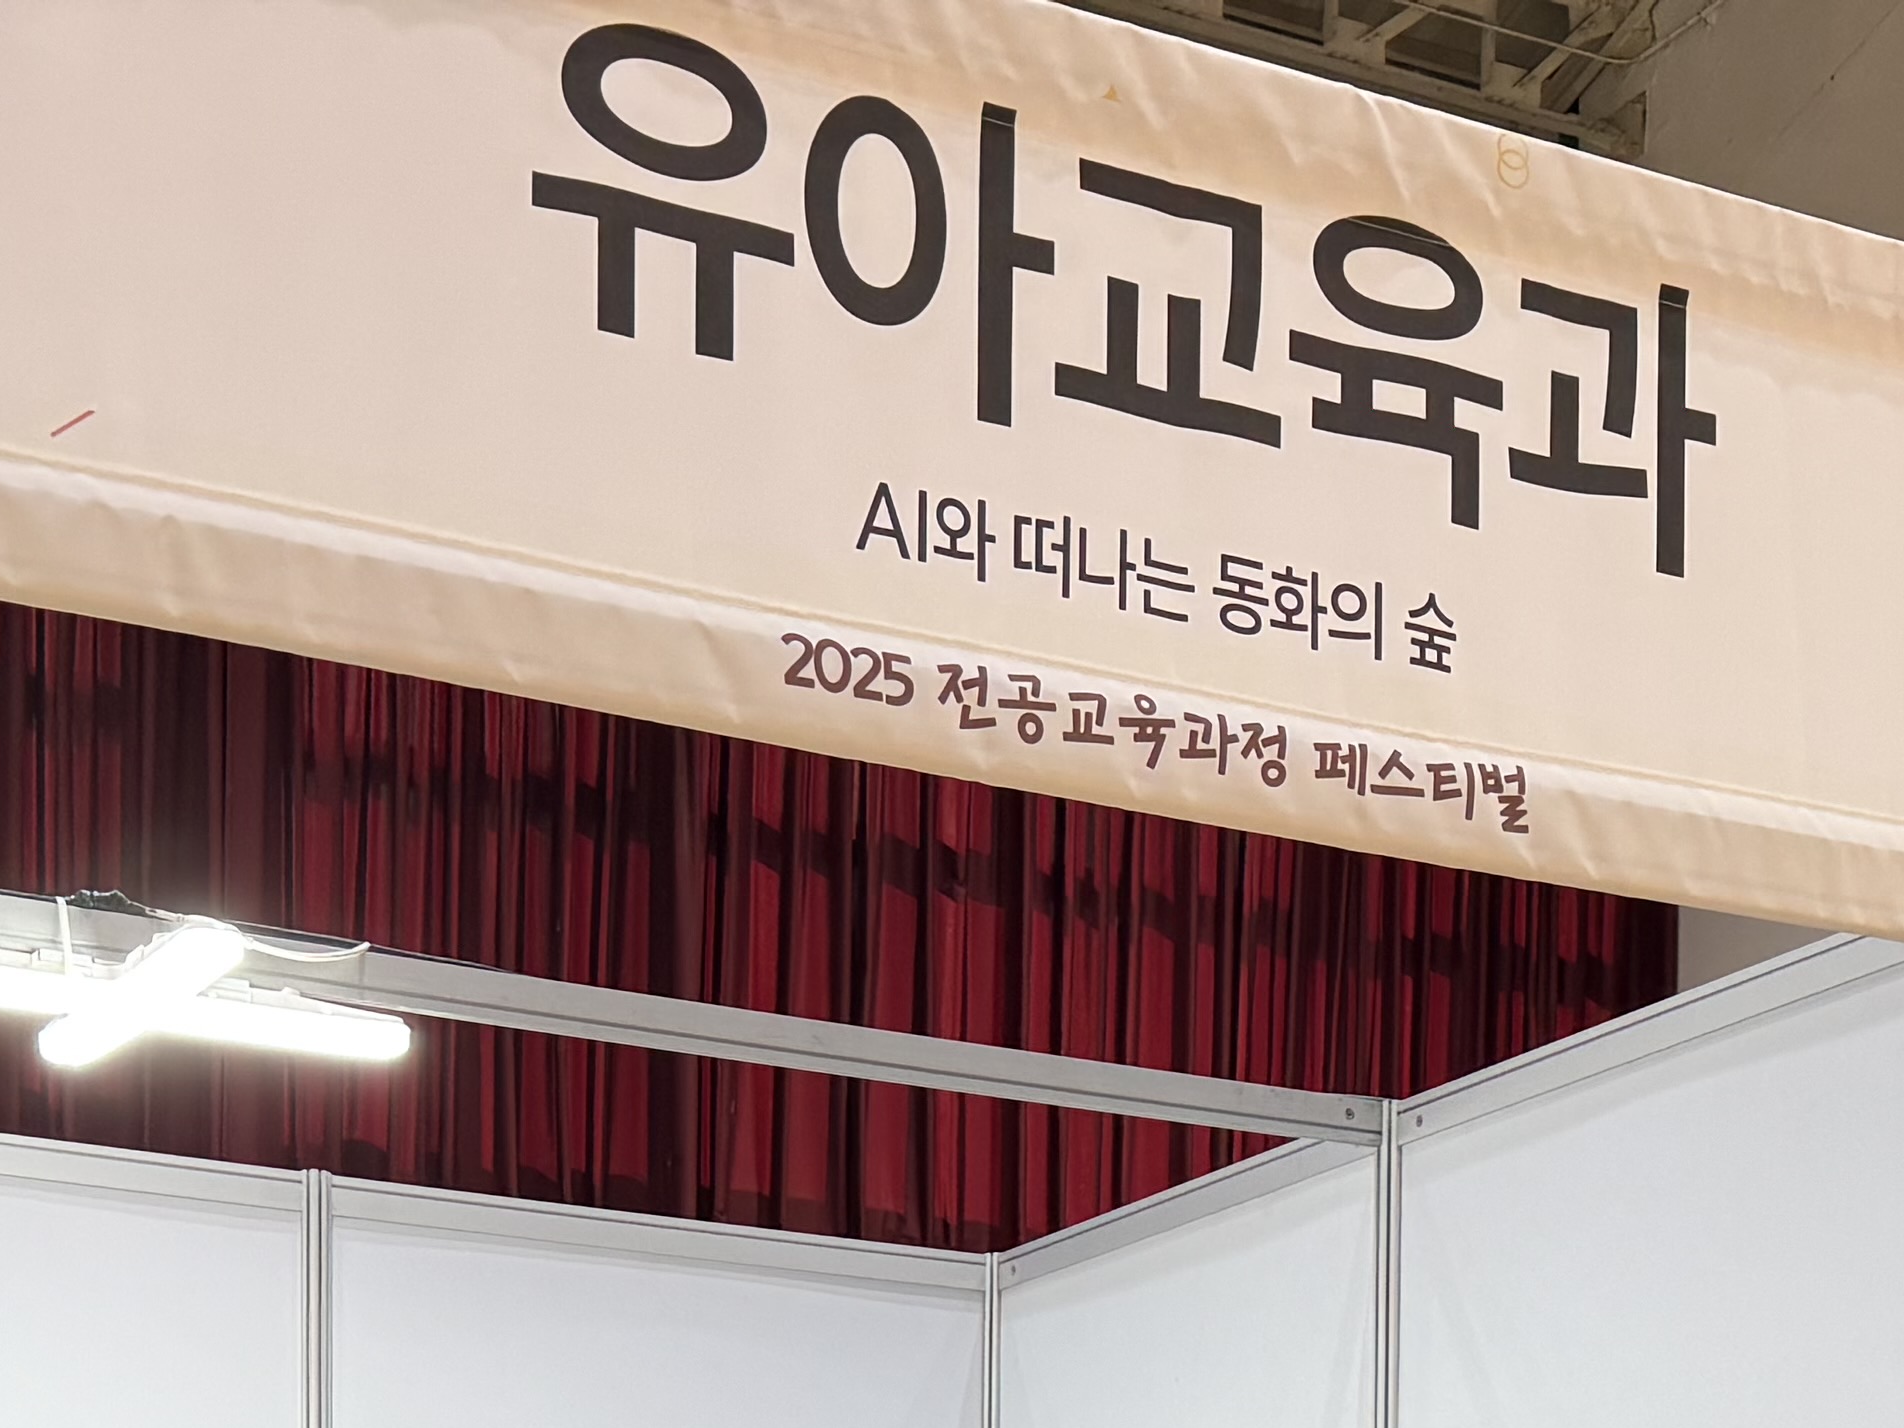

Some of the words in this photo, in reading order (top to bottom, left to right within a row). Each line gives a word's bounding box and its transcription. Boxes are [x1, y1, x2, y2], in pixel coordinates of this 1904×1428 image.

[532, 23, 1716, 578] 유아교육과
[856, 482, 996, 582] AI와
[1013, 514, 1196, 623] 떠나는
[1212, 557, 1384, 661] 동화의
[1405, 593, 1458, 674] 숲
[783, 634, 913, 707] 2025
[936, 660, 1289, 788] 전공교육과정
[1314, 739, 1530, 836] 페스티벌
